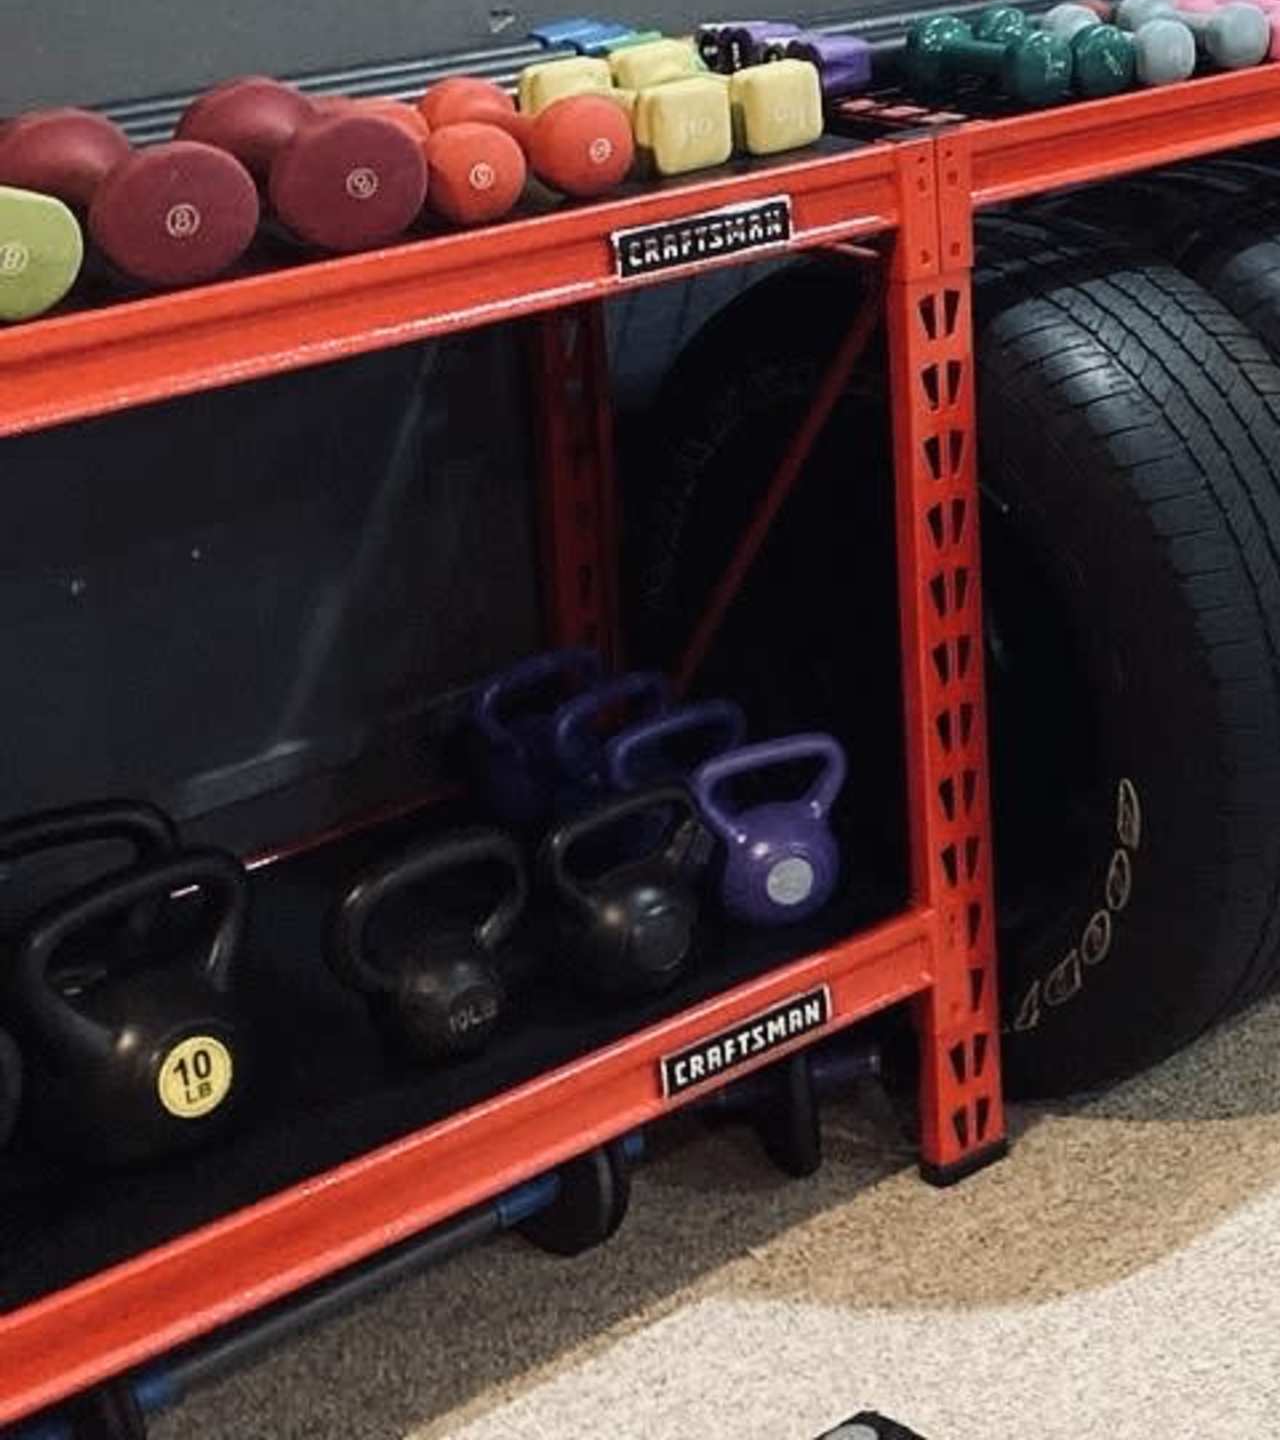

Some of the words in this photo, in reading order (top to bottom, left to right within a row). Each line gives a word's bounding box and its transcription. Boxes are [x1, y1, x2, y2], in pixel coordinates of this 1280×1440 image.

[628, 208, 784, 268] CRAFTSMAN
[173, 1049, 212, 1087] 10
[673, 999, 822, 1088] CRAFTSMAN
[185, 1081, 213, 1105] LB
